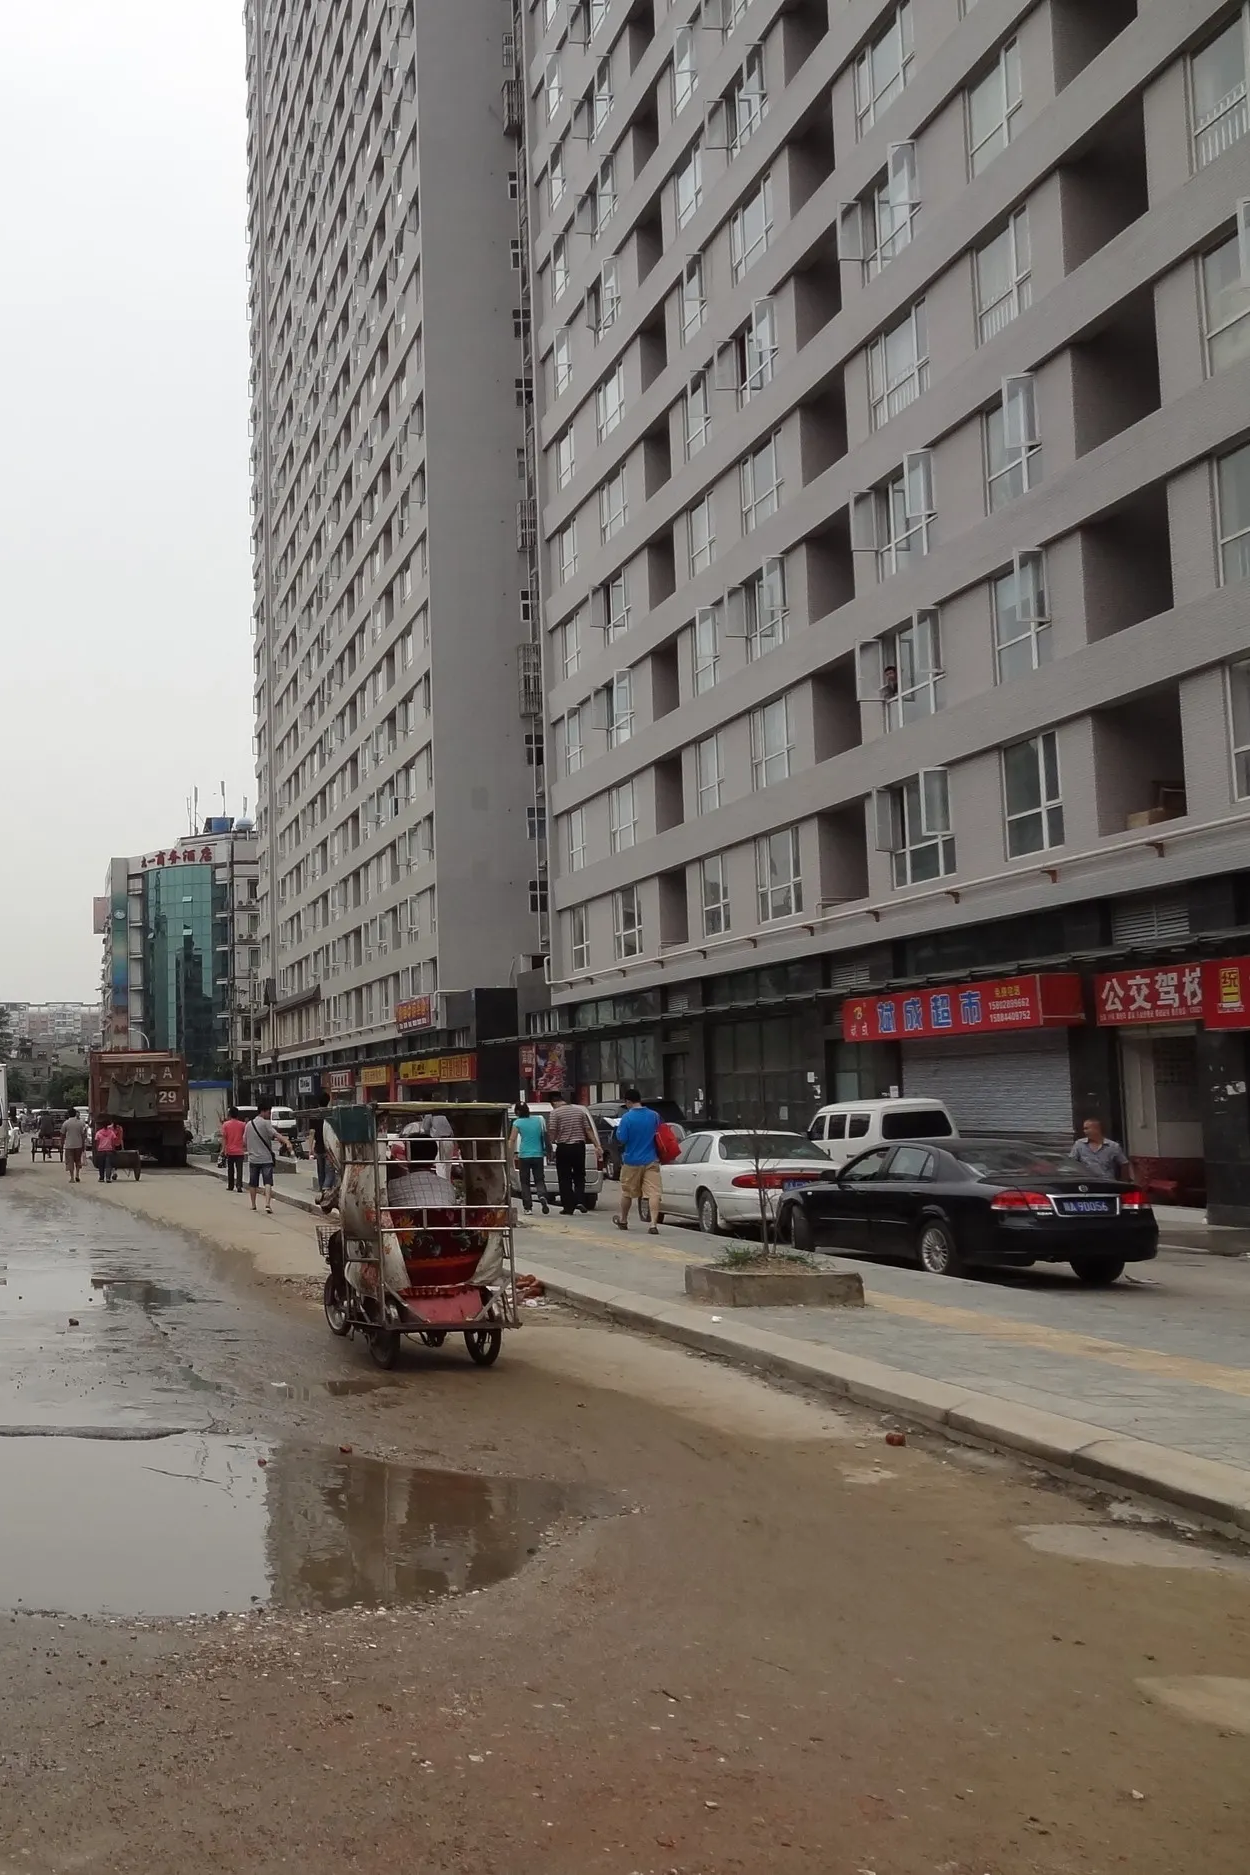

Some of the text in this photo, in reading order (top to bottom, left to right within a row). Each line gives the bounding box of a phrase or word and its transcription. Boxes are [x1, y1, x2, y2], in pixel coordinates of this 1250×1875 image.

[1101, 967, 1203, 1011] 公交驾校
[163, 1066, 173, 1079] A
[159, 1090, 177, 1103] 29
